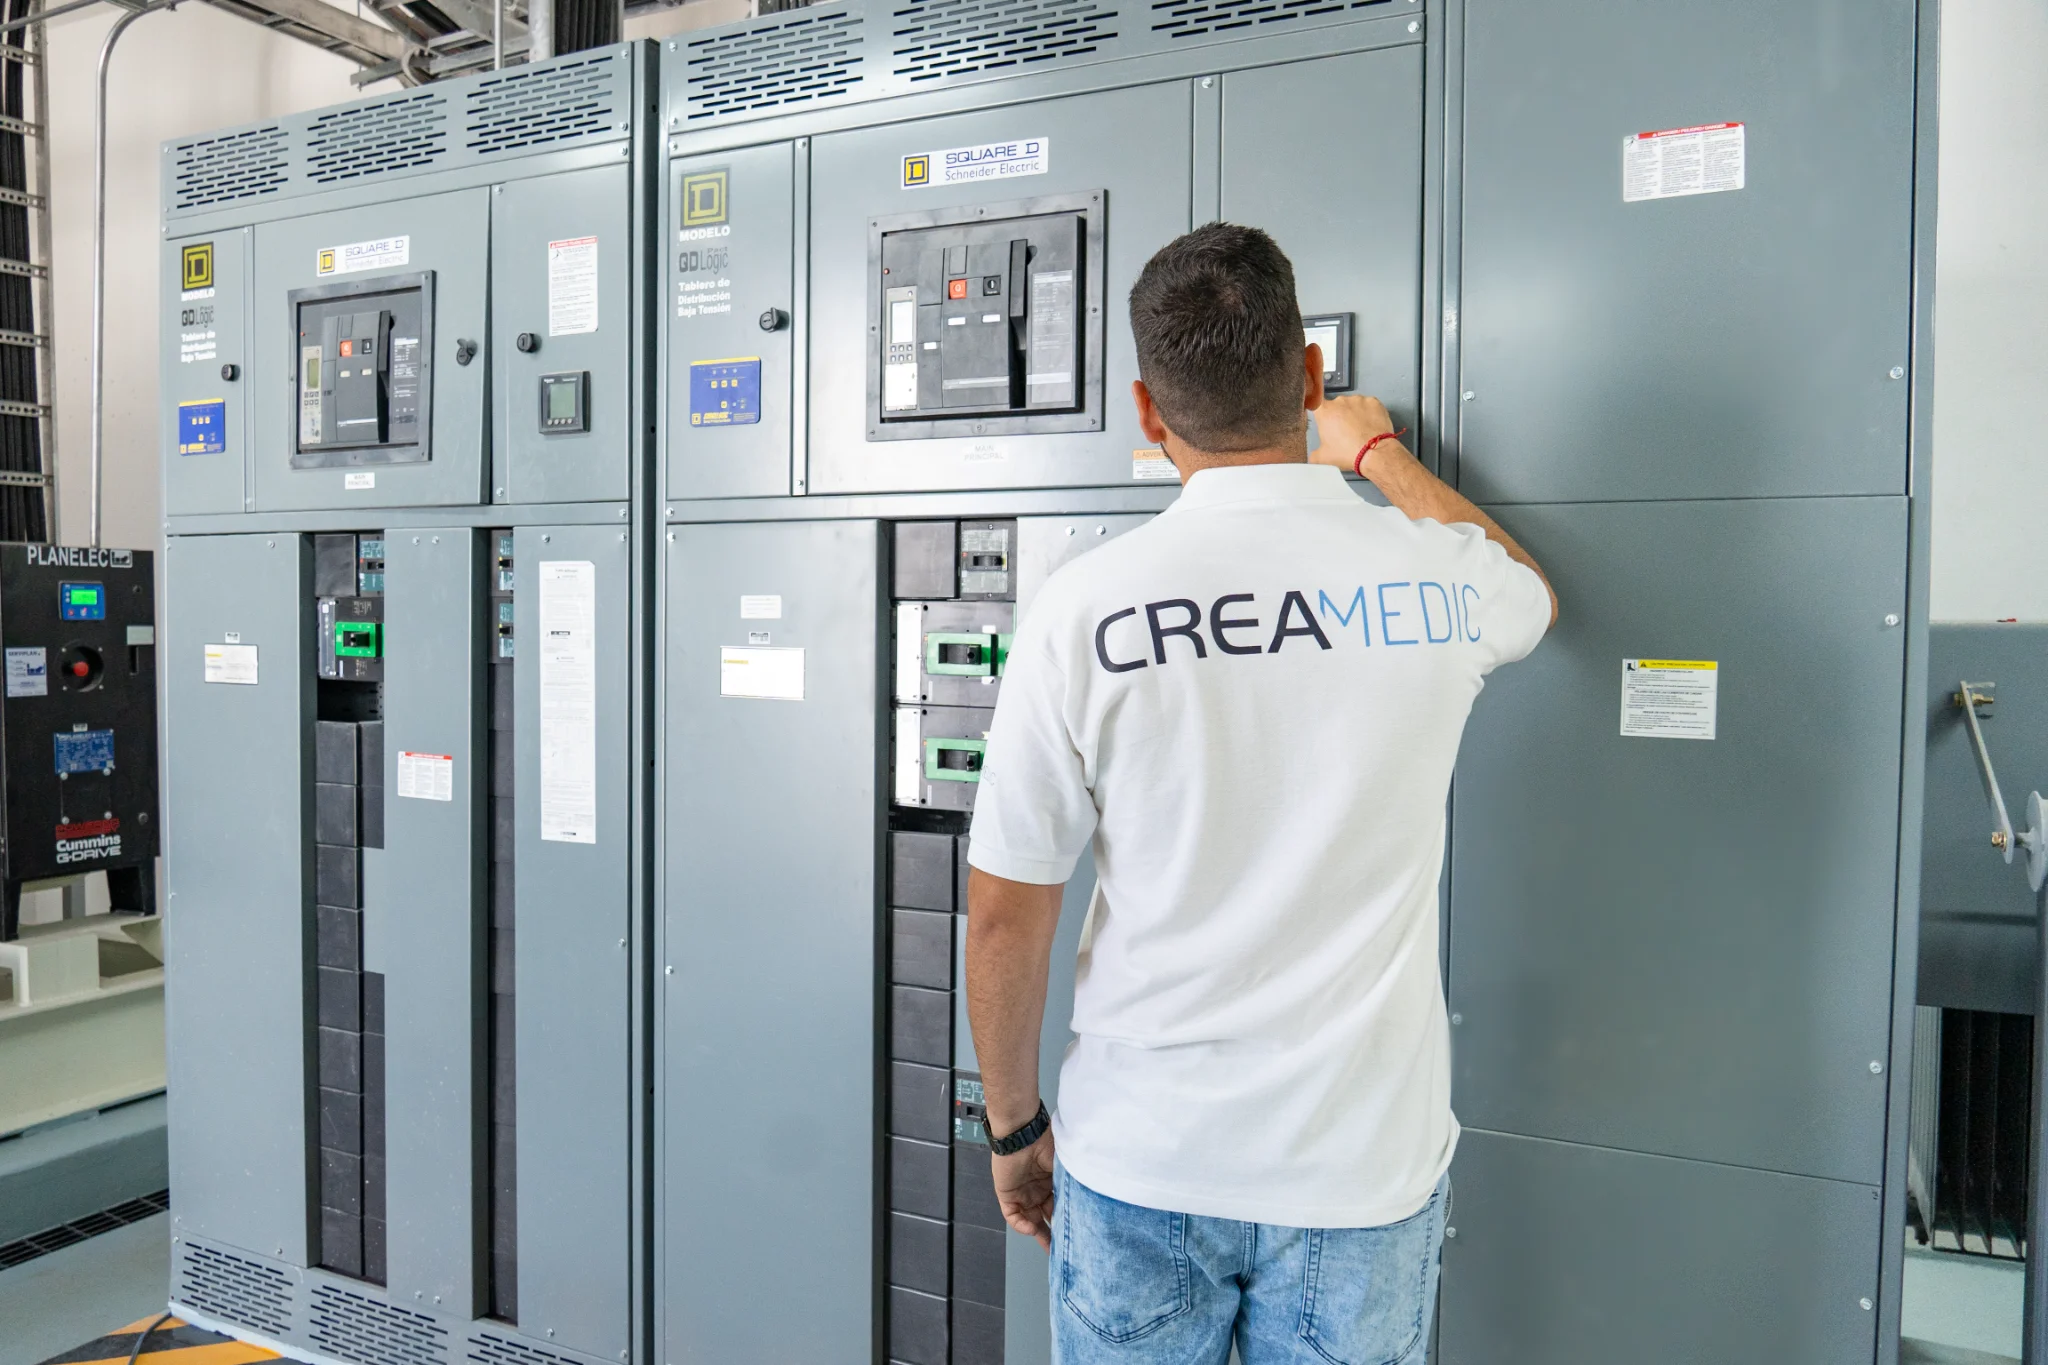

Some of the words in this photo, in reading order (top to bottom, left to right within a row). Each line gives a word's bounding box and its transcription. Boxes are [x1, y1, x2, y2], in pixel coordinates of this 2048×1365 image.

[946, 145, 1017, 165] SQUARE
[1025, 142, 1040, 155] D
[945, 166, 996, 182] Schneider
[1000, 161, 1039, 175] Electric
[679, 226, 731, 242] MODELO
[345, 241, 390, 257] SQUARE
[395, 239, 404, 249] D
[678, 280, 716, 292] Tablero
[718, 277, 731, 288] de
[677, 291, 731, 305] Distribución
[677, 306, 697, 318] Baja
[699, 303, 731, 315] Tensión
[964, 452, 1004, 461] PRINCIPAL
[27, 545, 108, 568] PLANELEC
[1095, 582, 1481, 673] CREAMEDIC
[56, 834, 121, 852] Cummins
[56, 845, 122, 864] G-DRIVE
